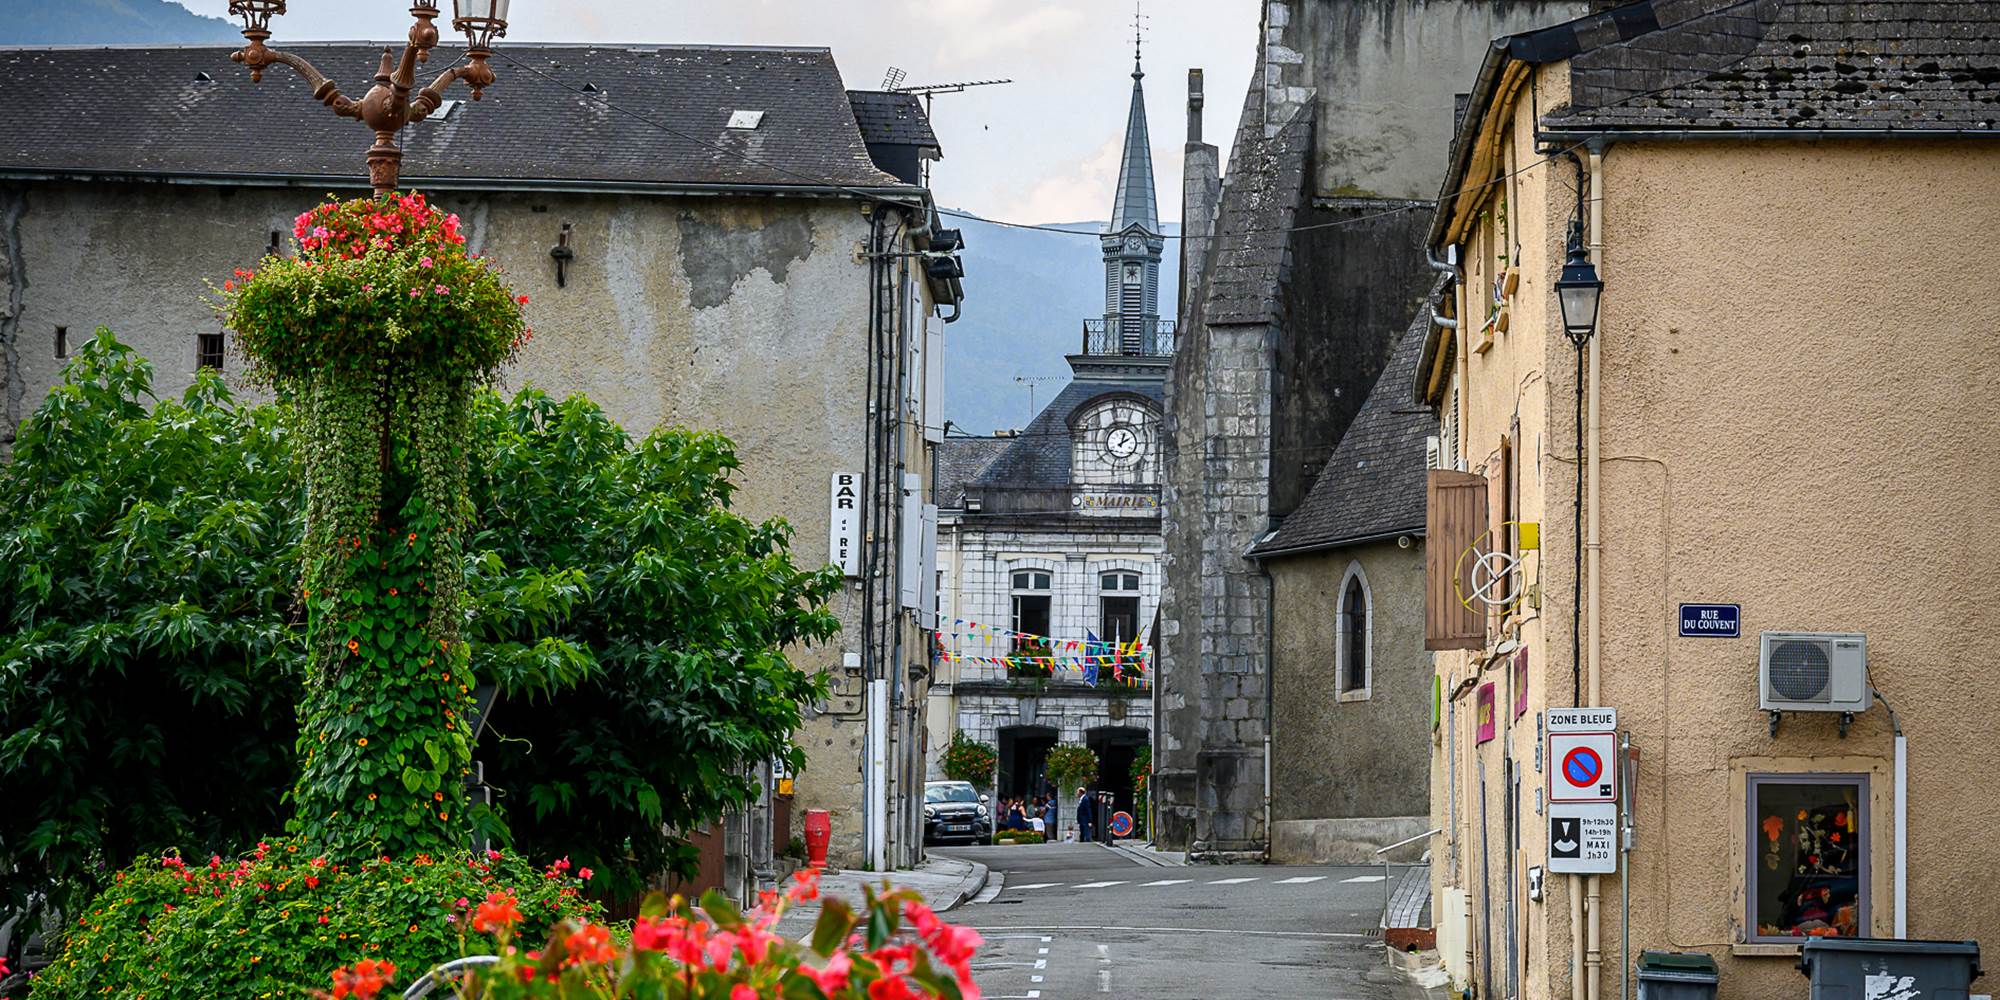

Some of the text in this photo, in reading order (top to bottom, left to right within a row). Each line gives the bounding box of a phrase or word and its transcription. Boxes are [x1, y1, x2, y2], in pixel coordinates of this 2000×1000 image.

[1096, 496, 1146, 507] MAIRIE
[837, 475, 855, 569] BAR du REY
[1700, 610, 1719, 619] RUE
[1684, 620, 1736, 629] DU COUVENT
[1550, 714, 1613, 725] ZONE BLEUE
[1586, 841, 1610, 849] MAXI
[1587, 852, 1609, 860] 1h30
